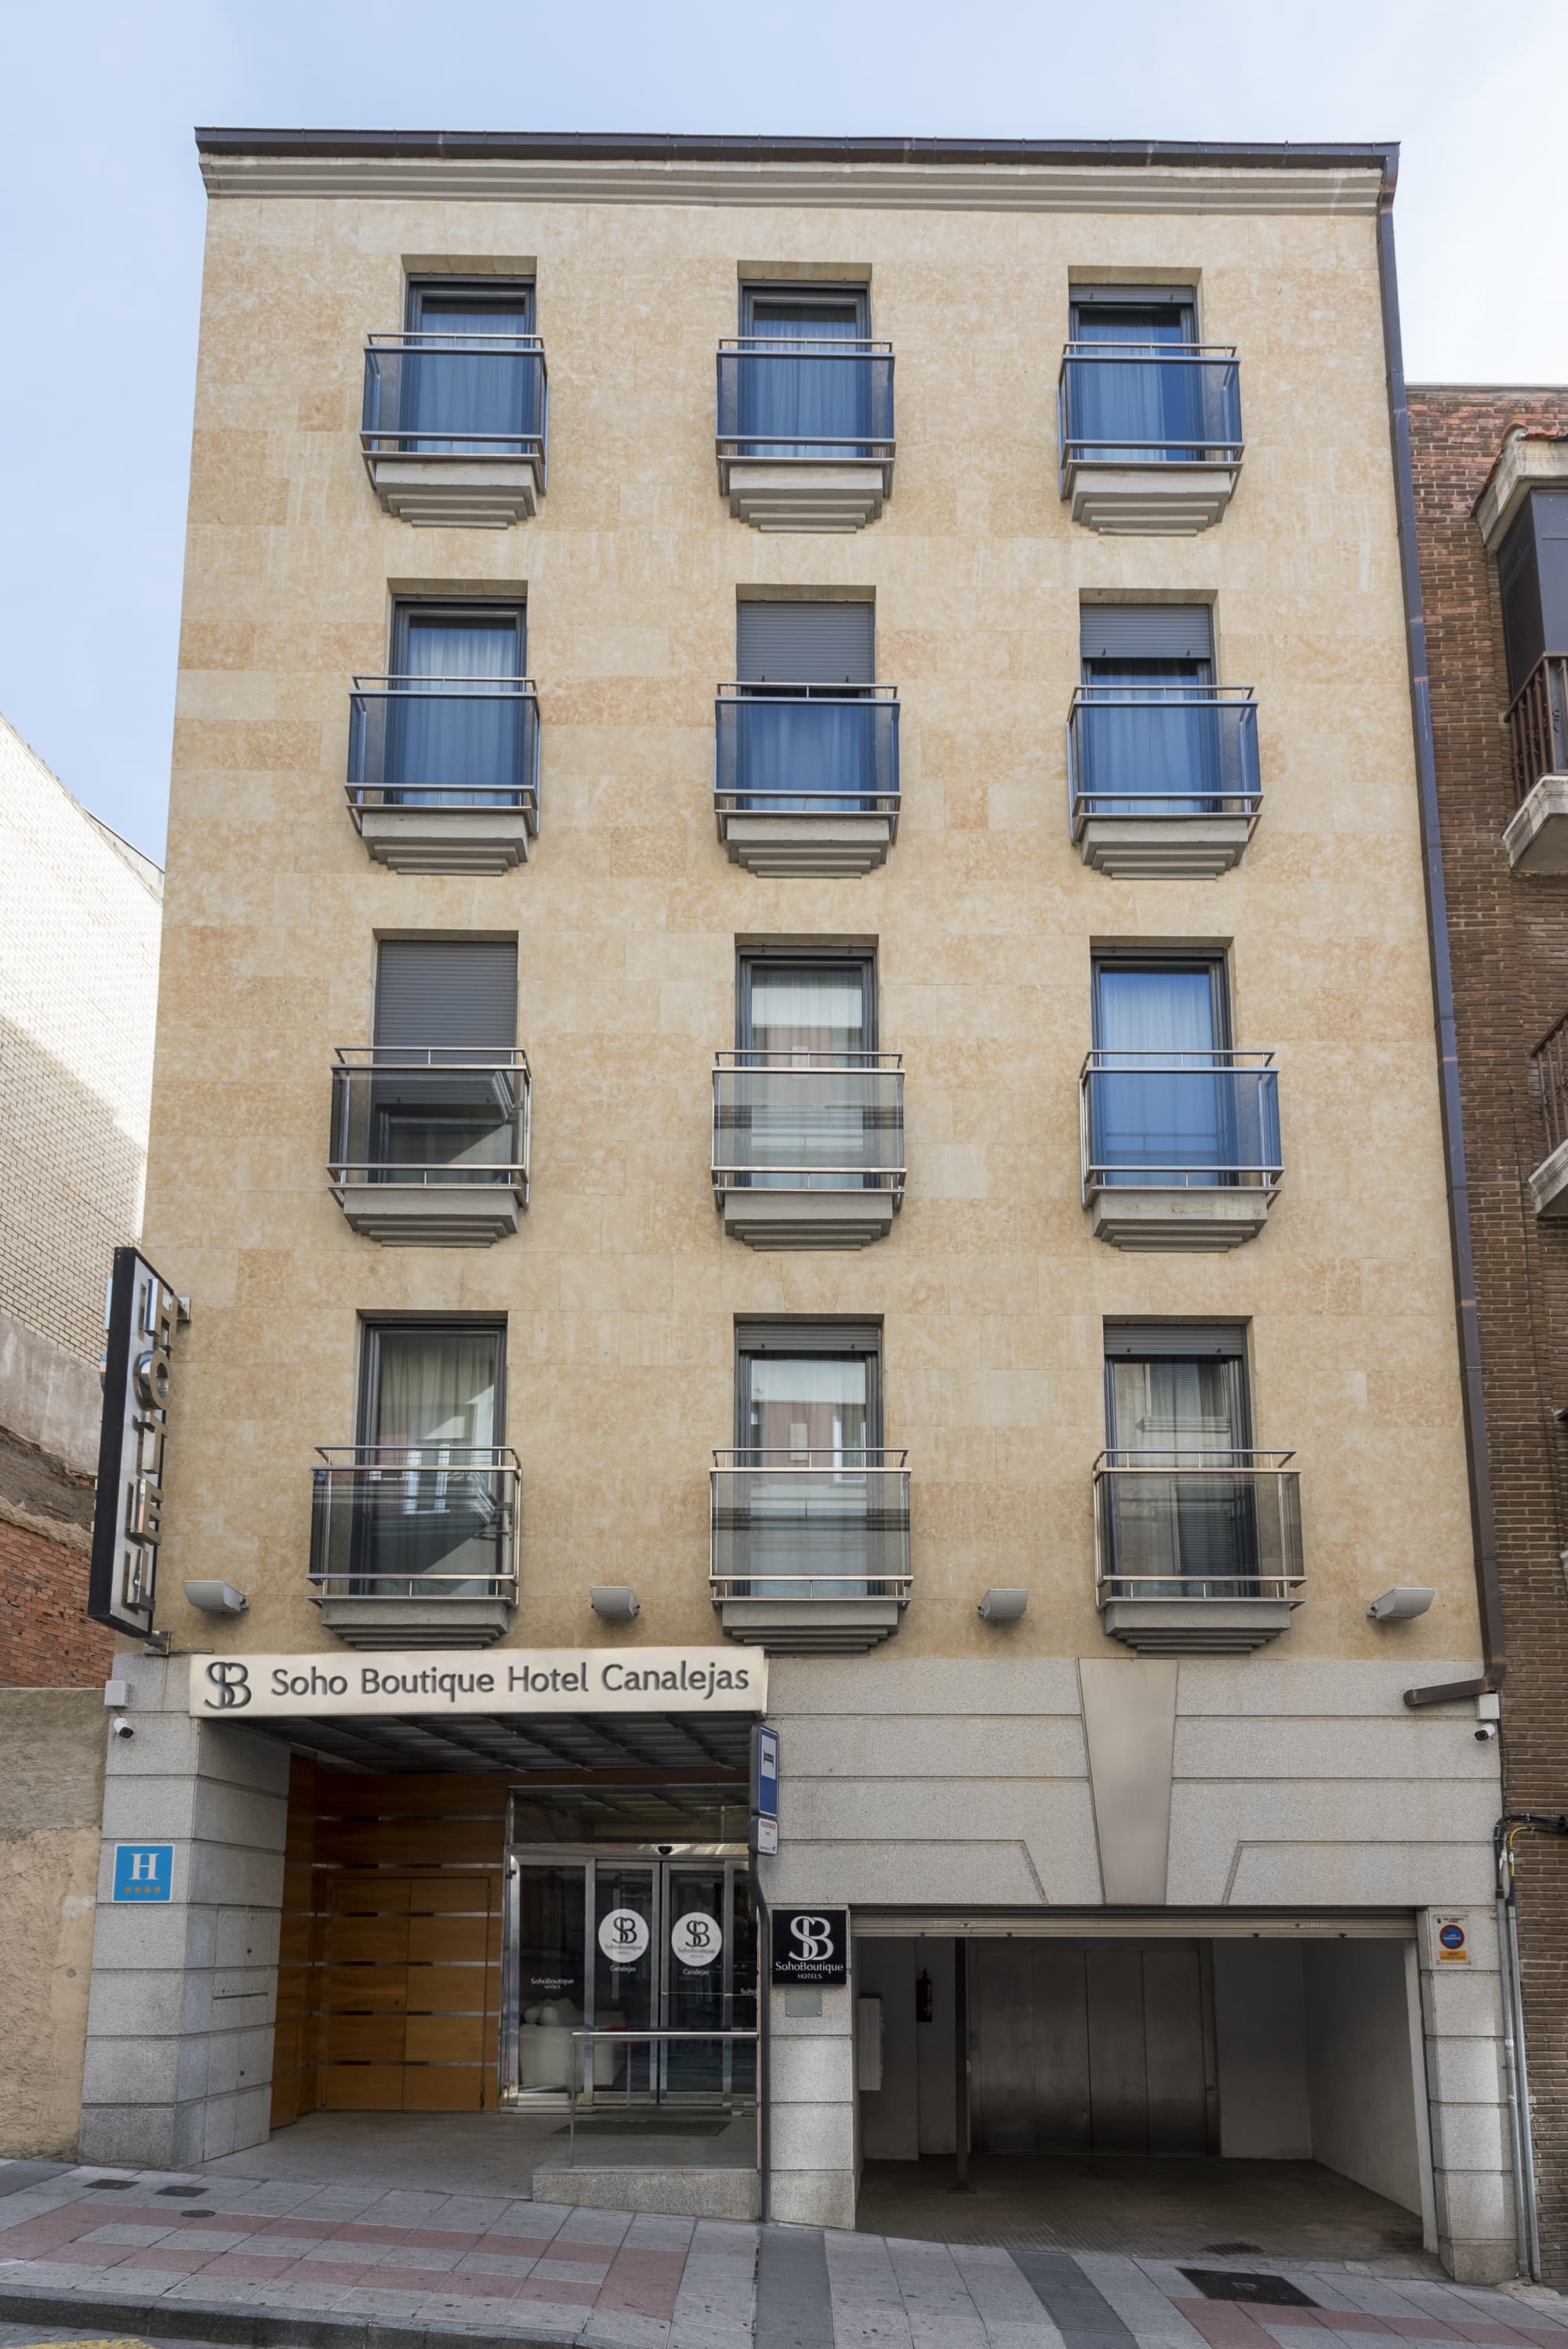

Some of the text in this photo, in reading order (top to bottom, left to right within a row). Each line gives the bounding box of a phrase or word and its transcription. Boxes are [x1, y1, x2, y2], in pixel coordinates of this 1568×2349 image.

[125, 1278, 174, 1612] HOTEL
[270, 1666, 347, 1696] Soho
[361, 1667, 495, 1703] Boutique
[508, 1661, 588, 1692] Hotel
[601, 1660, 750, 1700] Canalejas
[129, 1853, 162, 1880] H
[775, 1961, 844, 1974] SohoBoutique
